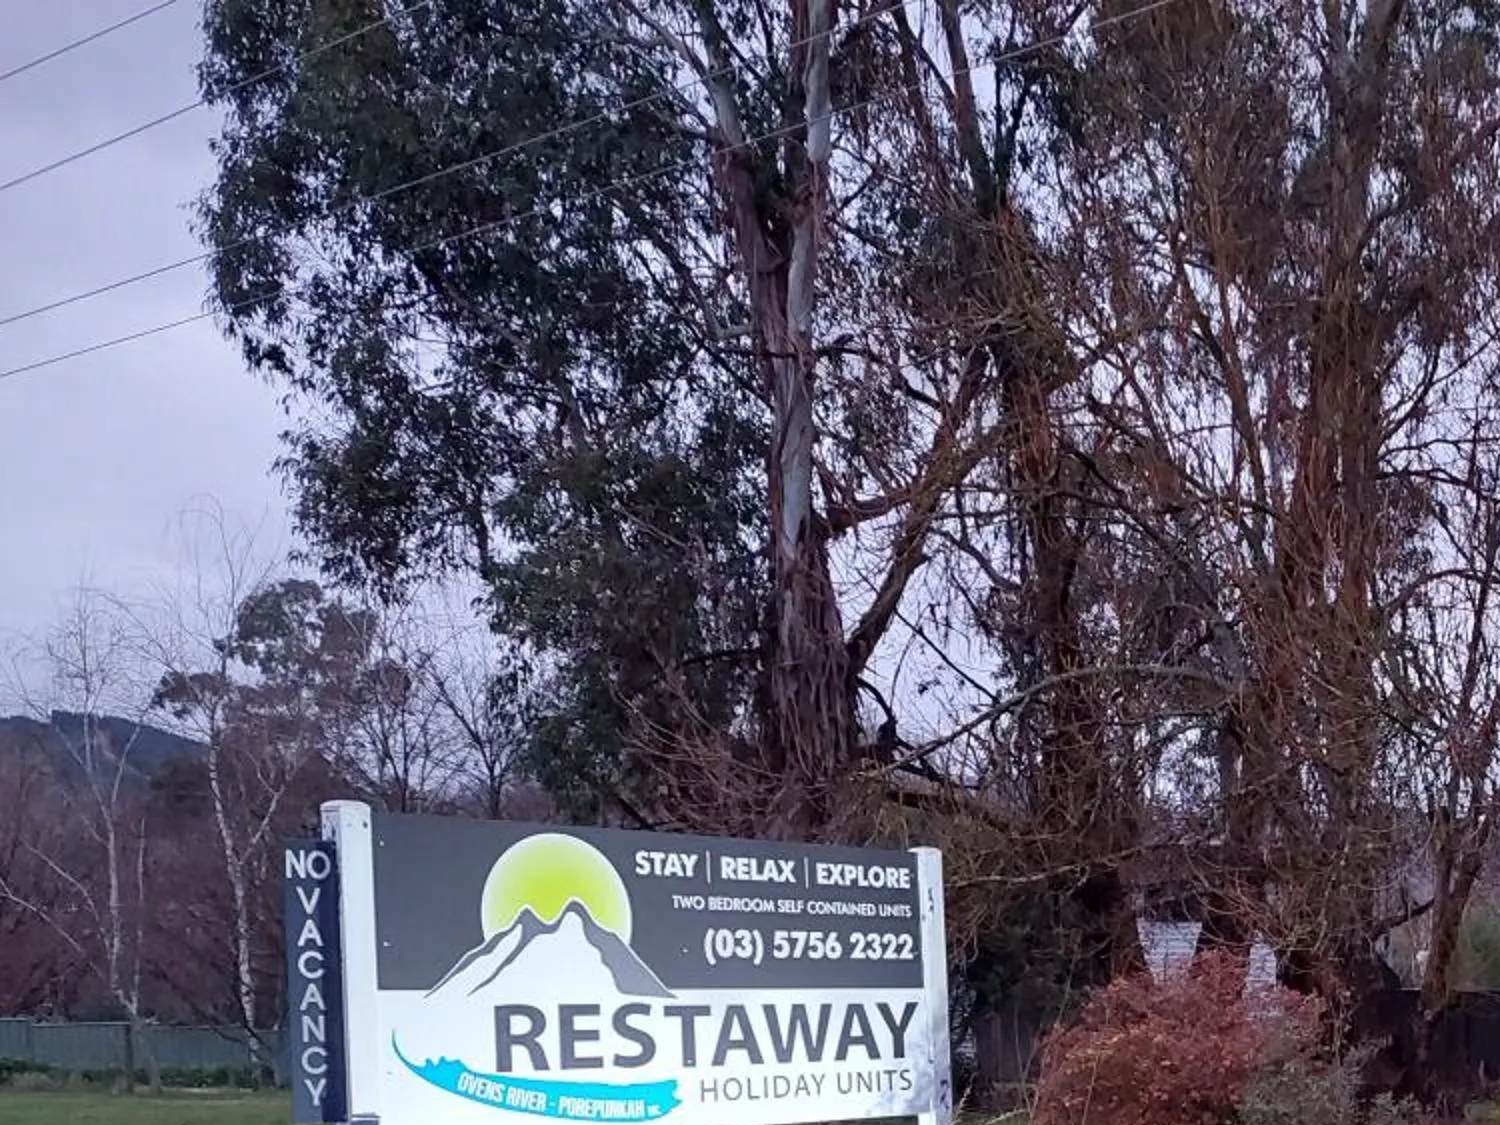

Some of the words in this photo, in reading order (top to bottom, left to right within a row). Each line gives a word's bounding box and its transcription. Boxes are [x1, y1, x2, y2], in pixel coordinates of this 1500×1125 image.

[285, 849, 331, 879] NO
[635, 850, 698, 877] STAY
[720, 856, 796, 882] RELAX
[816, 862, 911, 889] EXPLORE
[672, 895, 704, 910] TWO
[708, 896, 774, 913] BEDROOM
[778, 899, 804, 914] SELF
[808, 901, 876, 917] CONTAINED
[879, 904, 912, 918] UNITS
[703, 928, 764, 965] (03)
[772, 931, 842, 959] 5756
[849, 932, 914, 960] 2322
[296, 886, 328, 1107] VACANCY
[493, 1001, 919, 1072] RESTAWAY
[457, 1072, 505, 1103] OVENS
[505, 1086, 547, 1112] RIVER
[700, 1073, 826, 1103] HOLIDAY
[836, 1069, 912, 1094] UNITS
